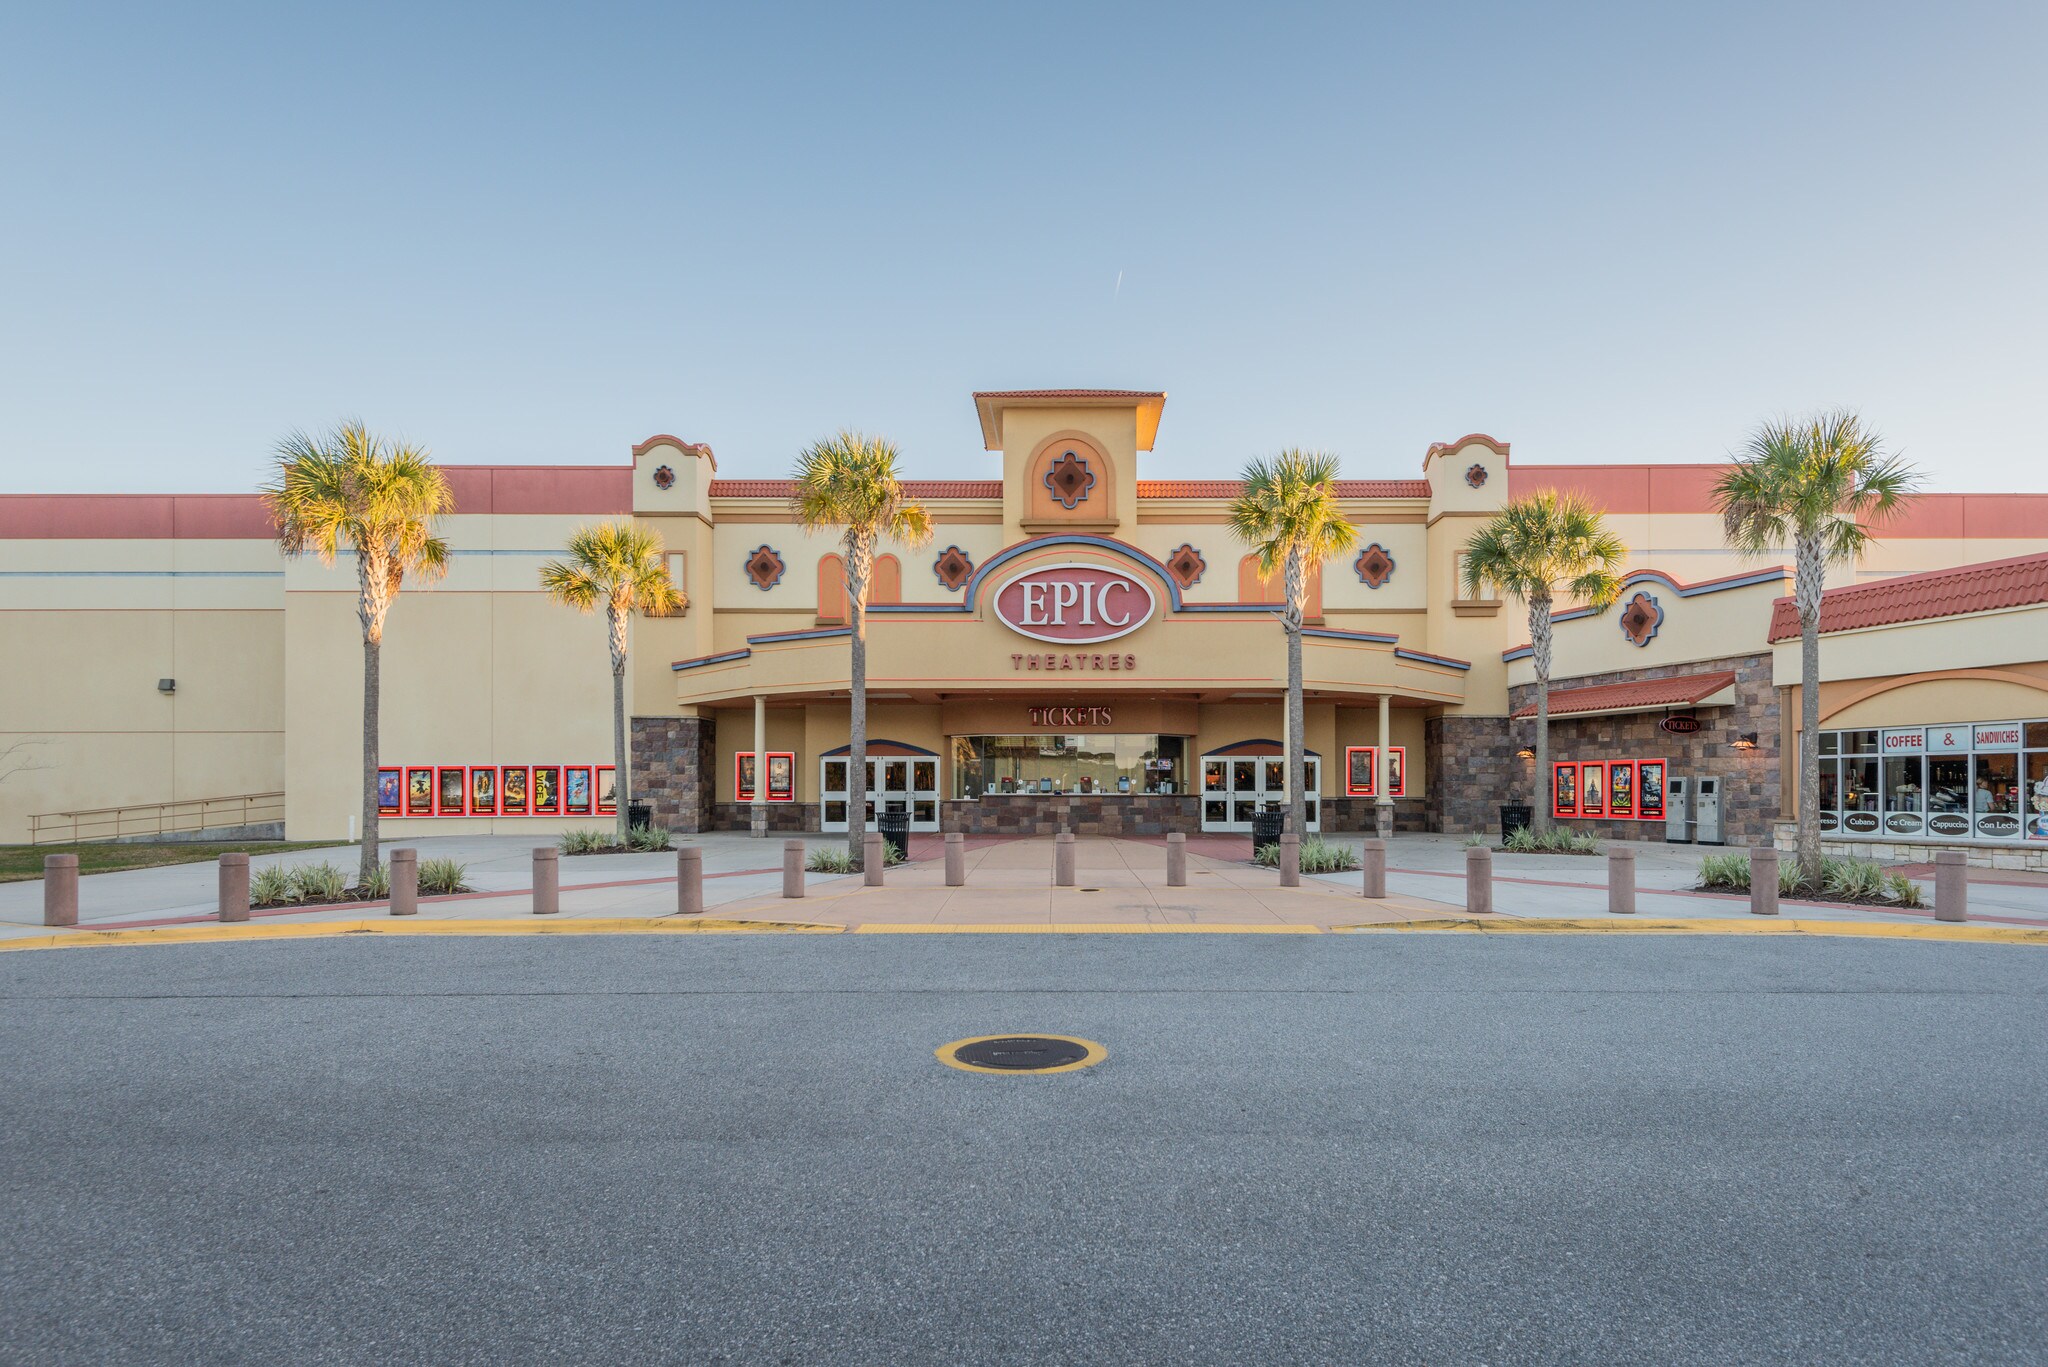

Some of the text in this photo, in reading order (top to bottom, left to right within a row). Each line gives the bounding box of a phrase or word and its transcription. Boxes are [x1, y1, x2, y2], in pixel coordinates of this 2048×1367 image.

[1018, 580, 1131, 627] EPIC
[1011, 653, 1137, 671] THEATRES
[1028, 706, 1112, 726] TICKETS
[1667, 720, 1698, 730] TICKETS
[1885, 730, 2019, 748] COFFEE & SANDWICHES
[536, 775, 544, 799] VICE
[1849, 817, 1876, 826] Cubano
[1887, 818, 1922, 827] Ice Cream
[1931, 820, 1969, 830] Cappuccino
[1978, 821, 2020, 829] Con Leche
